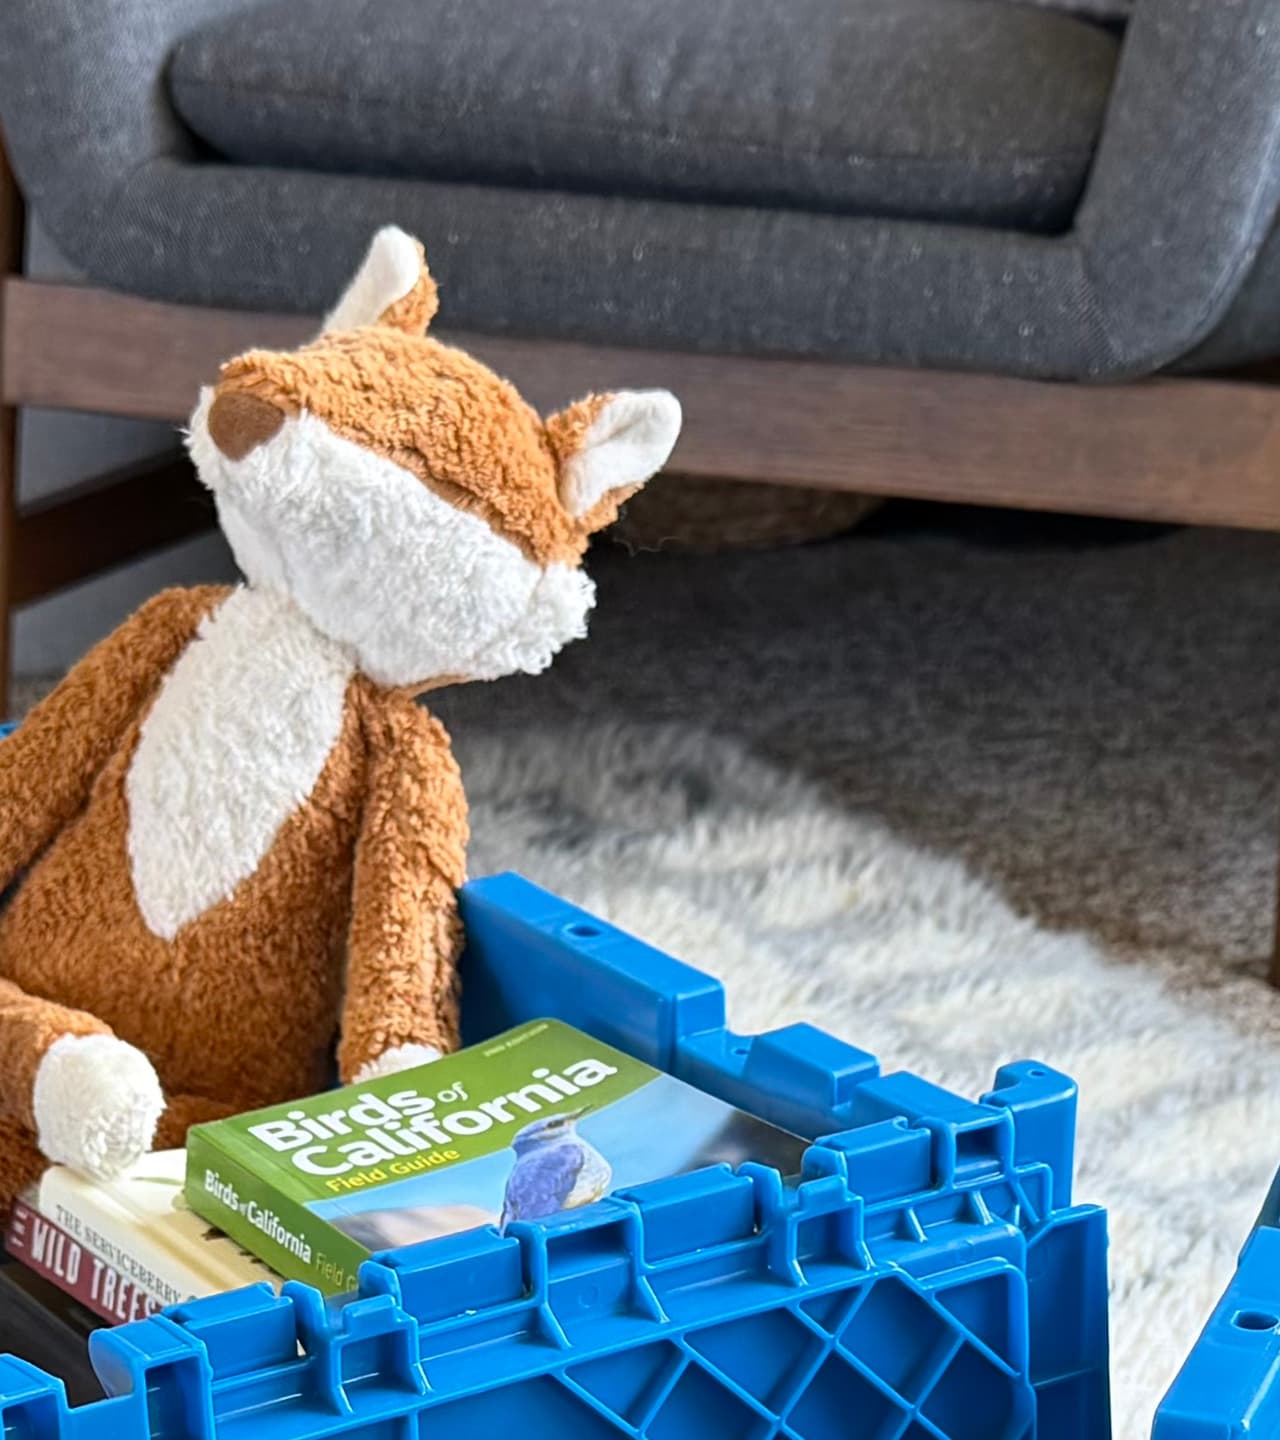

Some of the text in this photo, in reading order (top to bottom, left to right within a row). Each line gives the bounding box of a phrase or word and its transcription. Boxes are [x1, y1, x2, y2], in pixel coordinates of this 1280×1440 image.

[247, 1080, 472, 1154] Birds of
[290, 1052, 619, 1177] California
[325, 1145, 462, 1195] Field Guide
[30, 1215, 163, 1321] WILD TREES
[54, 1204, 182, 1306] THE SERVICEBERRY
[204, 1169, 241, 1212] Birds
[246, 1200, 312, 1264] California
[315, 1252, 345, 1287] Field
